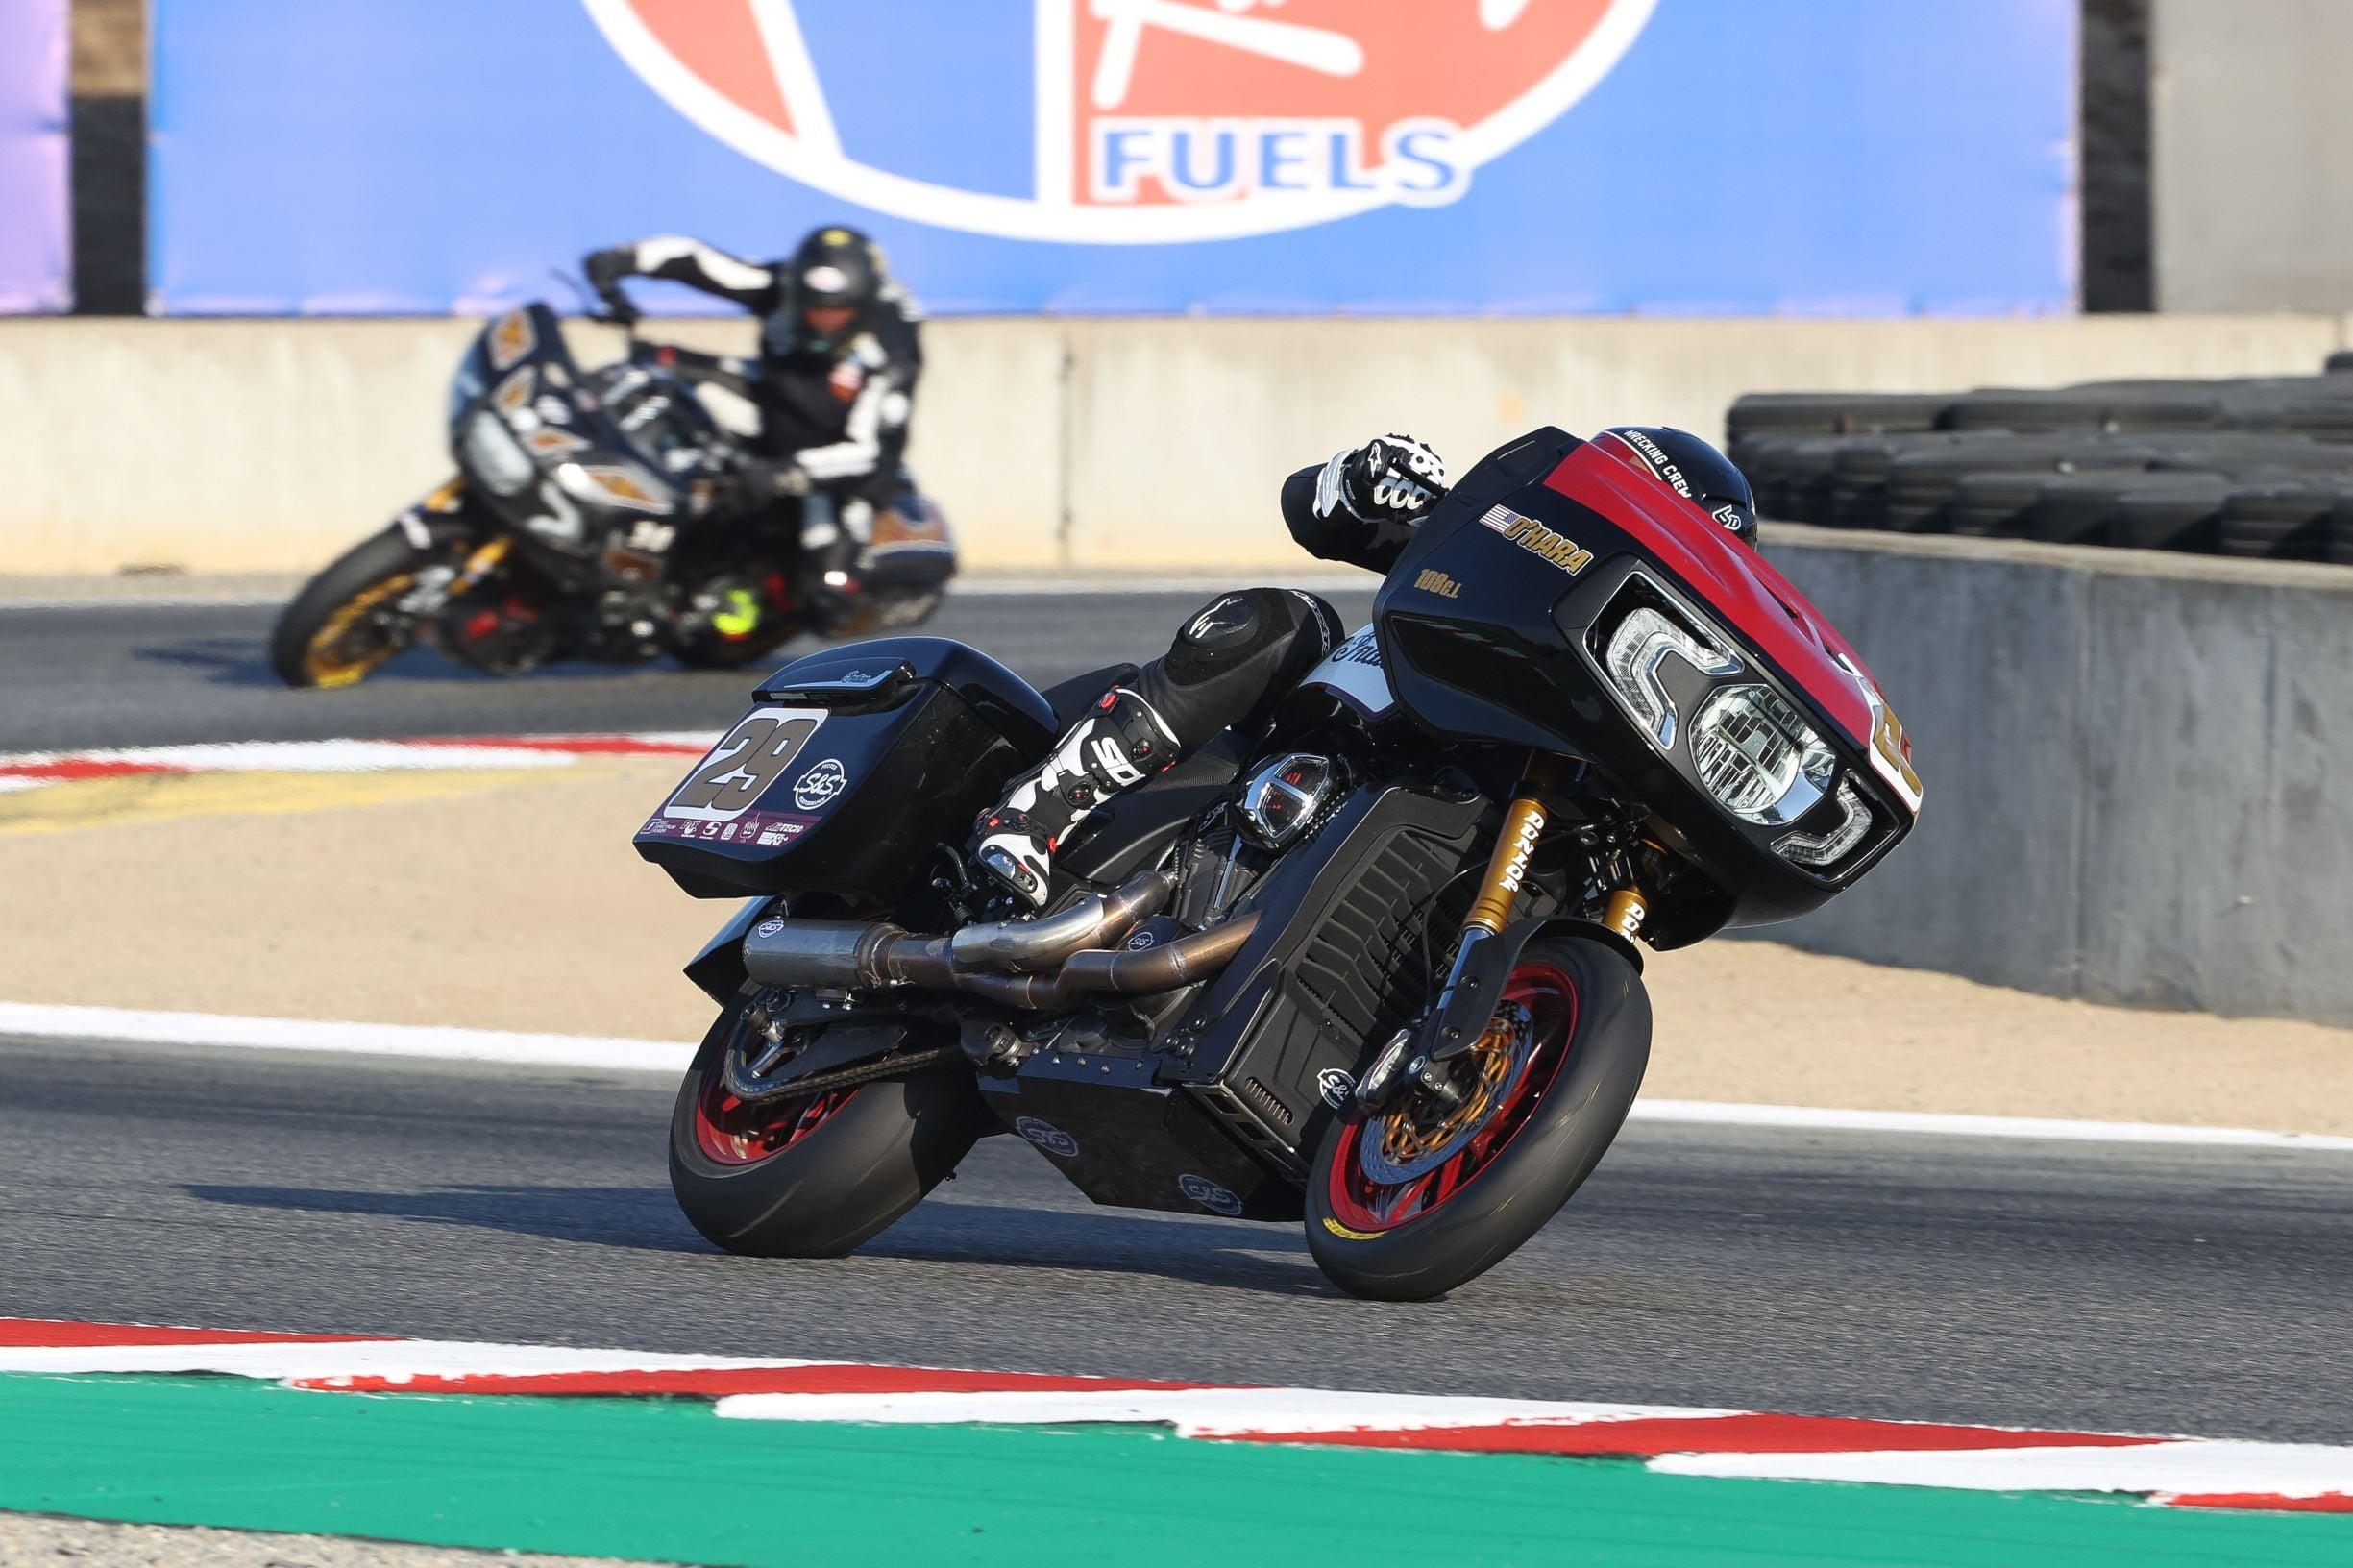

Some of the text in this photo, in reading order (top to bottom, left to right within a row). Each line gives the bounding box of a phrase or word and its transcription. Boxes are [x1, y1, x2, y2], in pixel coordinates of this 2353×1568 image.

[1098, 125, 1464, 198] FUELS
[1624, 429, 1692, 499] WRECKING CREW
[1504, 516, 1594, 576] O'HARA
[671, 717, 818, 811] 29
[798, 772, 842, 796] S&S
